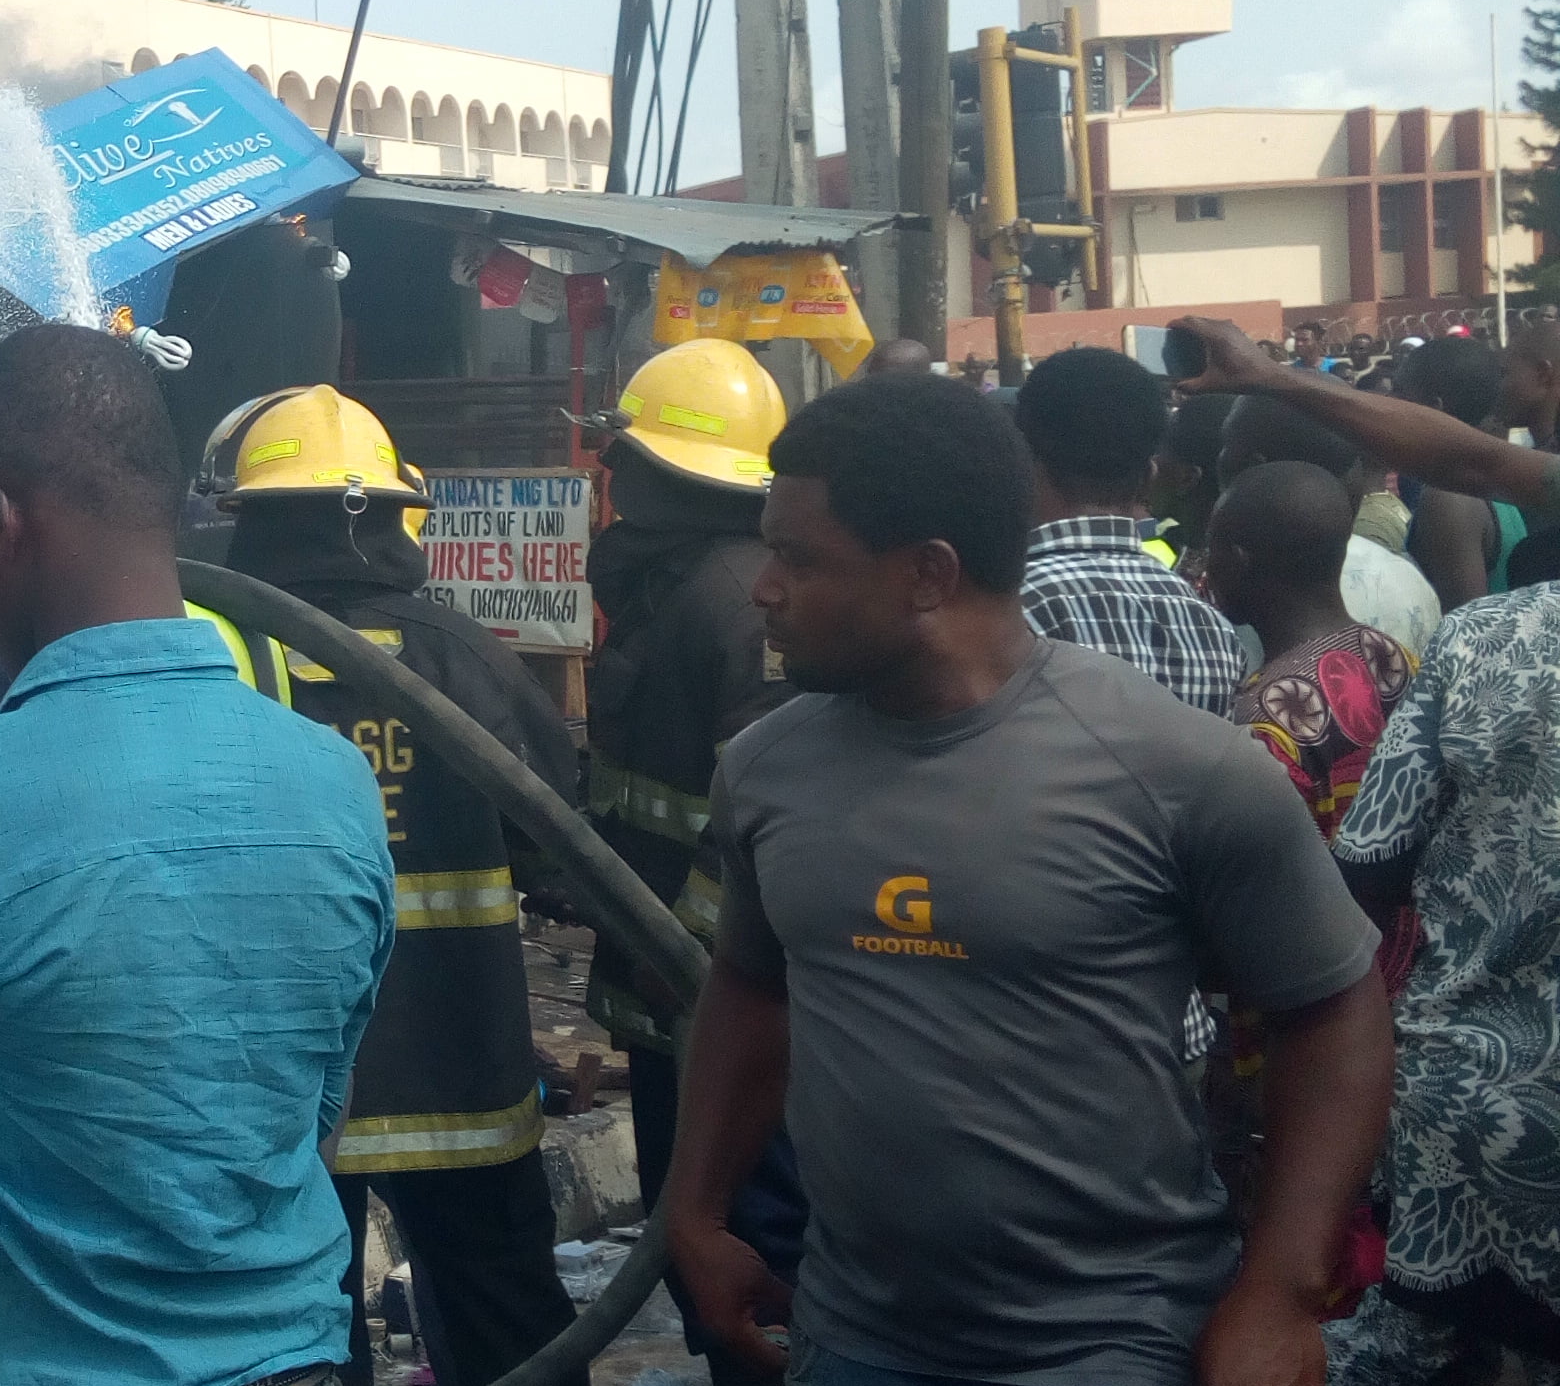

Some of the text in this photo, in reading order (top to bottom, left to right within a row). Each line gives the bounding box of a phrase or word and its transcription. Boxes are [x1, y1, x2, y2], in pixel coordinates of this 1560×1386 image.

[52, 134, 154, 193] live
[153, 132, 272, 188] Natives
[143, 192, 258, 251] MEN & LADIES
[426, 478, 503, 507] ANDATE
[512, 479, 541, 507] NIG
[442, 512, 491, 537] PLOTS
[497, 512, 516, 537] OF
[523, 512, 565, 537] LAND
[523, 542, 585, 583] HERE
[875, 875, 934, 934] G
[852, 935, 970, 960] FOOTBALL
